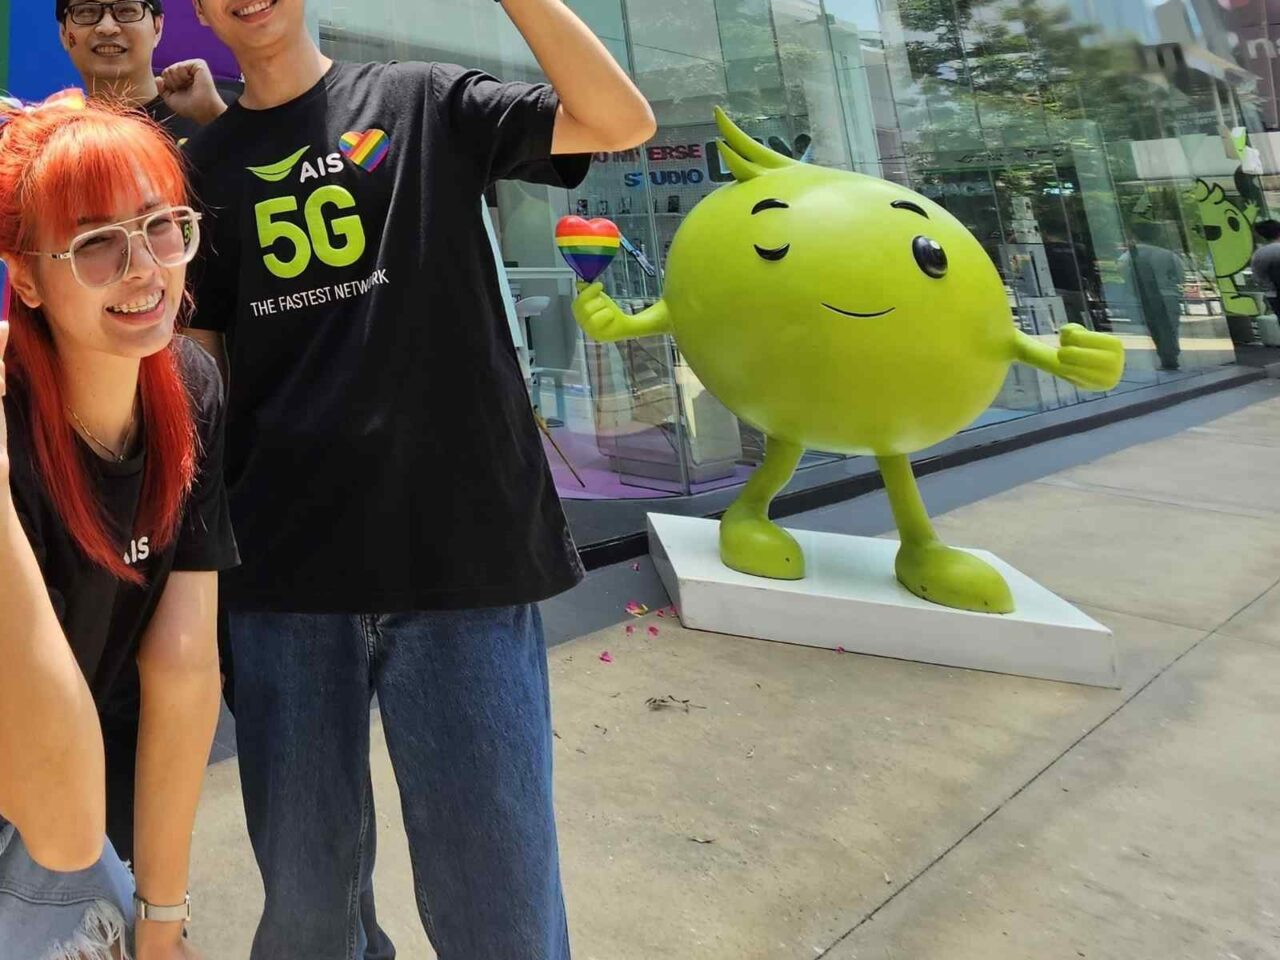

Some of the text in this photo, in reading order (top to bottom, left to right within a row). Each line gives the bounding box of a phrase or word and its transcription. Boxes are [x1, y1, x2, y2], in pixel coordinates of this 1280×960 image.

[298, 152, 345, 183] AIS
[623, 168, 704, 187] SUDIO
[254, 184, 366, 279] 5G
[249, 298, 278, 318] THE
[278, 286, 333, 313] FASTEST
